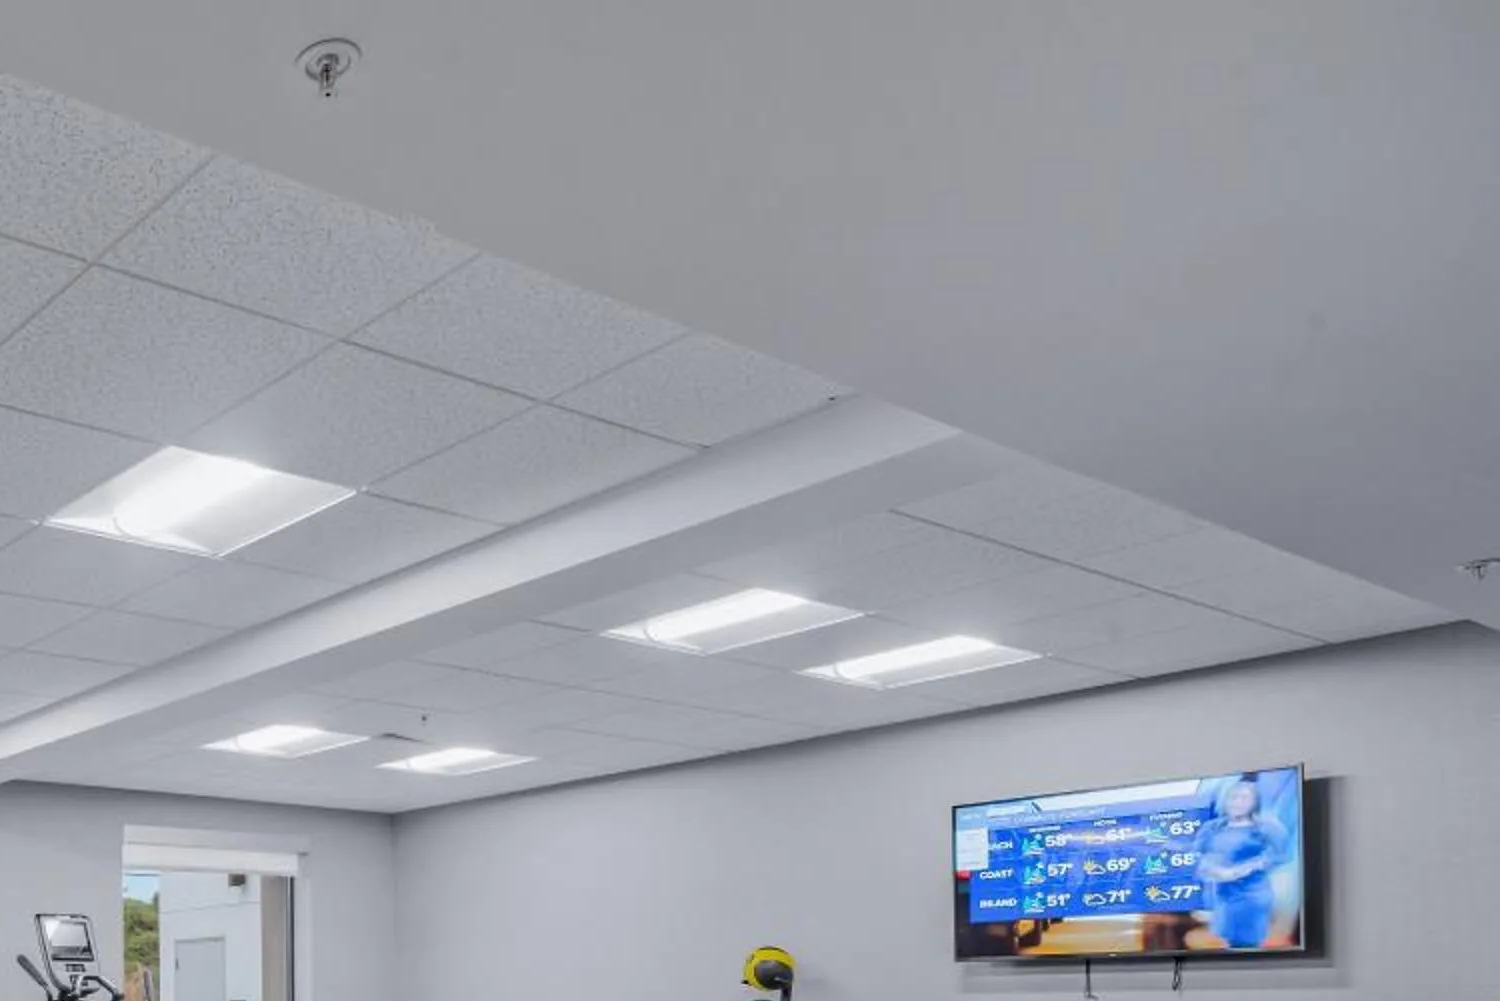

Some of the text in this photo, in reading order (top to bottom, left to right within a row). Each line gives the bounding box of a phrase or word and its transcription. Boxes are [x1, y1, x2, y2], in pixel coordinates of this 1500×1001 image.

[980, 868, 1013, 880] COAST
[1106, 857, 1137, 872] 69°
[1107, 889, 1132, 903] 71°
[1171, 885, 1201, 899] 77°
